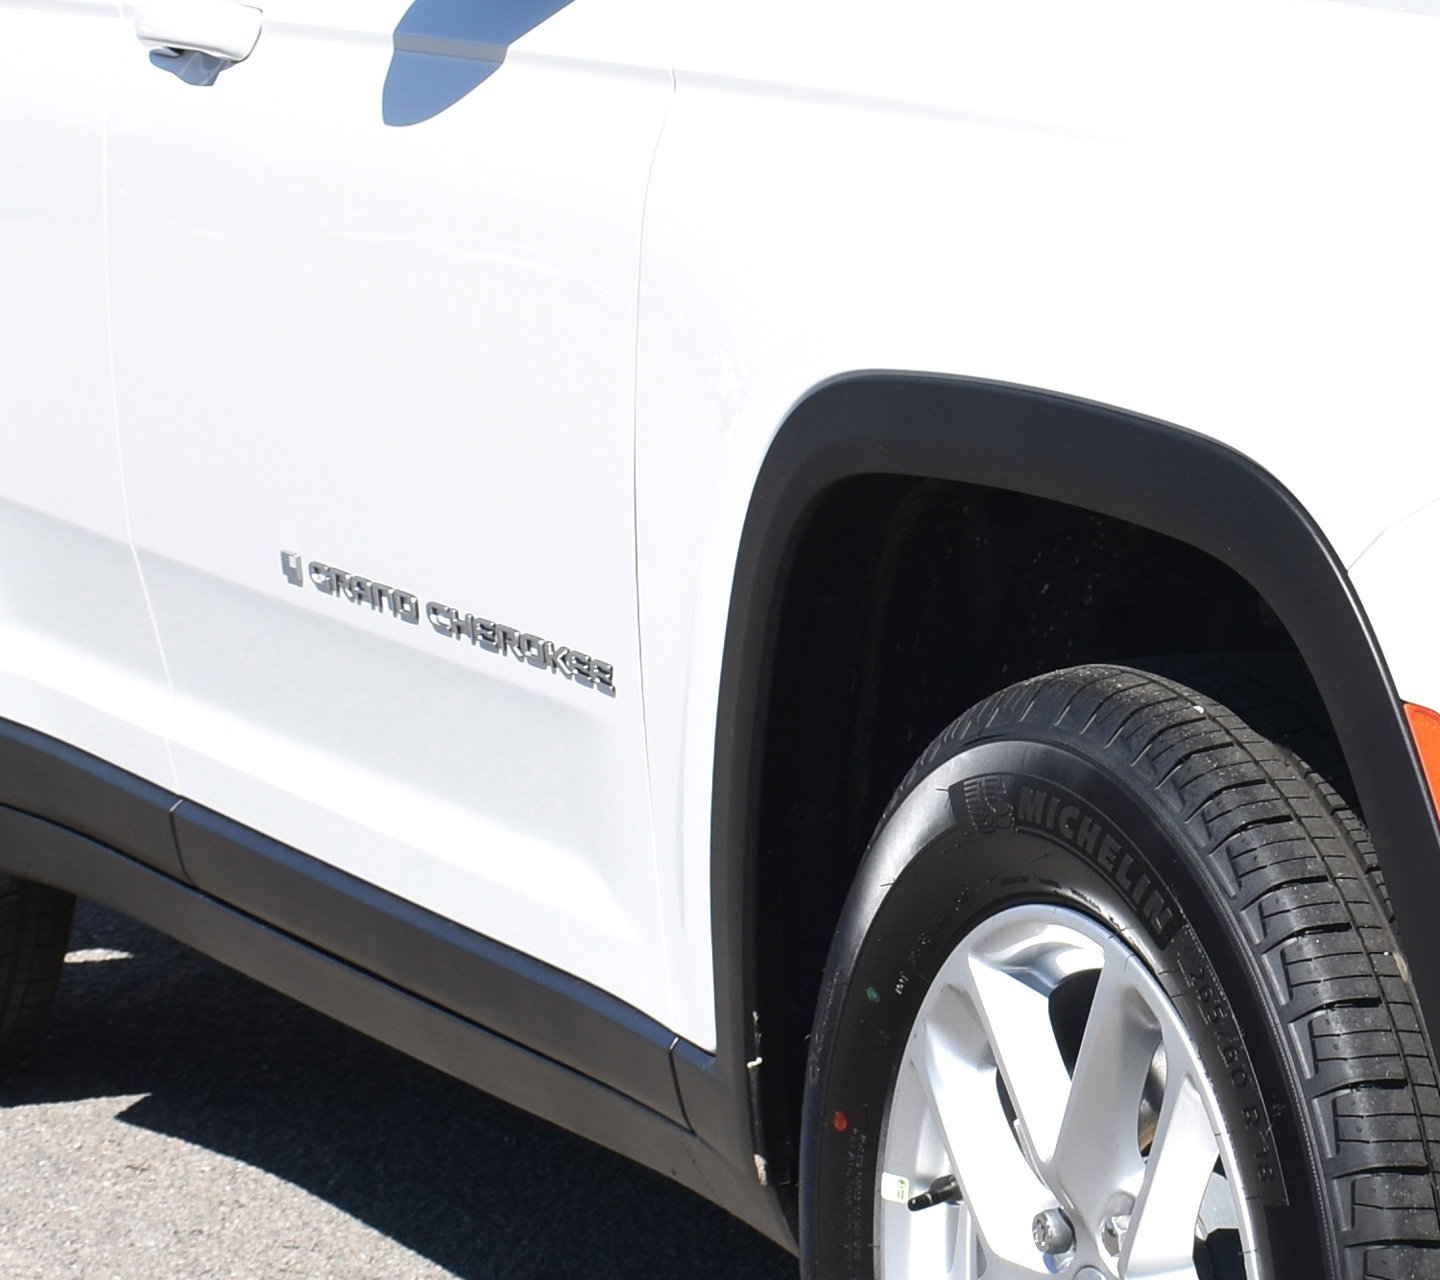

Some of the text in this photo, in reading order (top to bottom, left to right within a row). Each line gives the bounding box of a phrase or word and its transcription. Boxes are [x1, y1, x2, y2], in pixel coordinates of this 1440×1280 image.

[308, 560, 617, 699] GRAND CHEROKEE
[1017, 786, 1174, 935] MICHELIN
